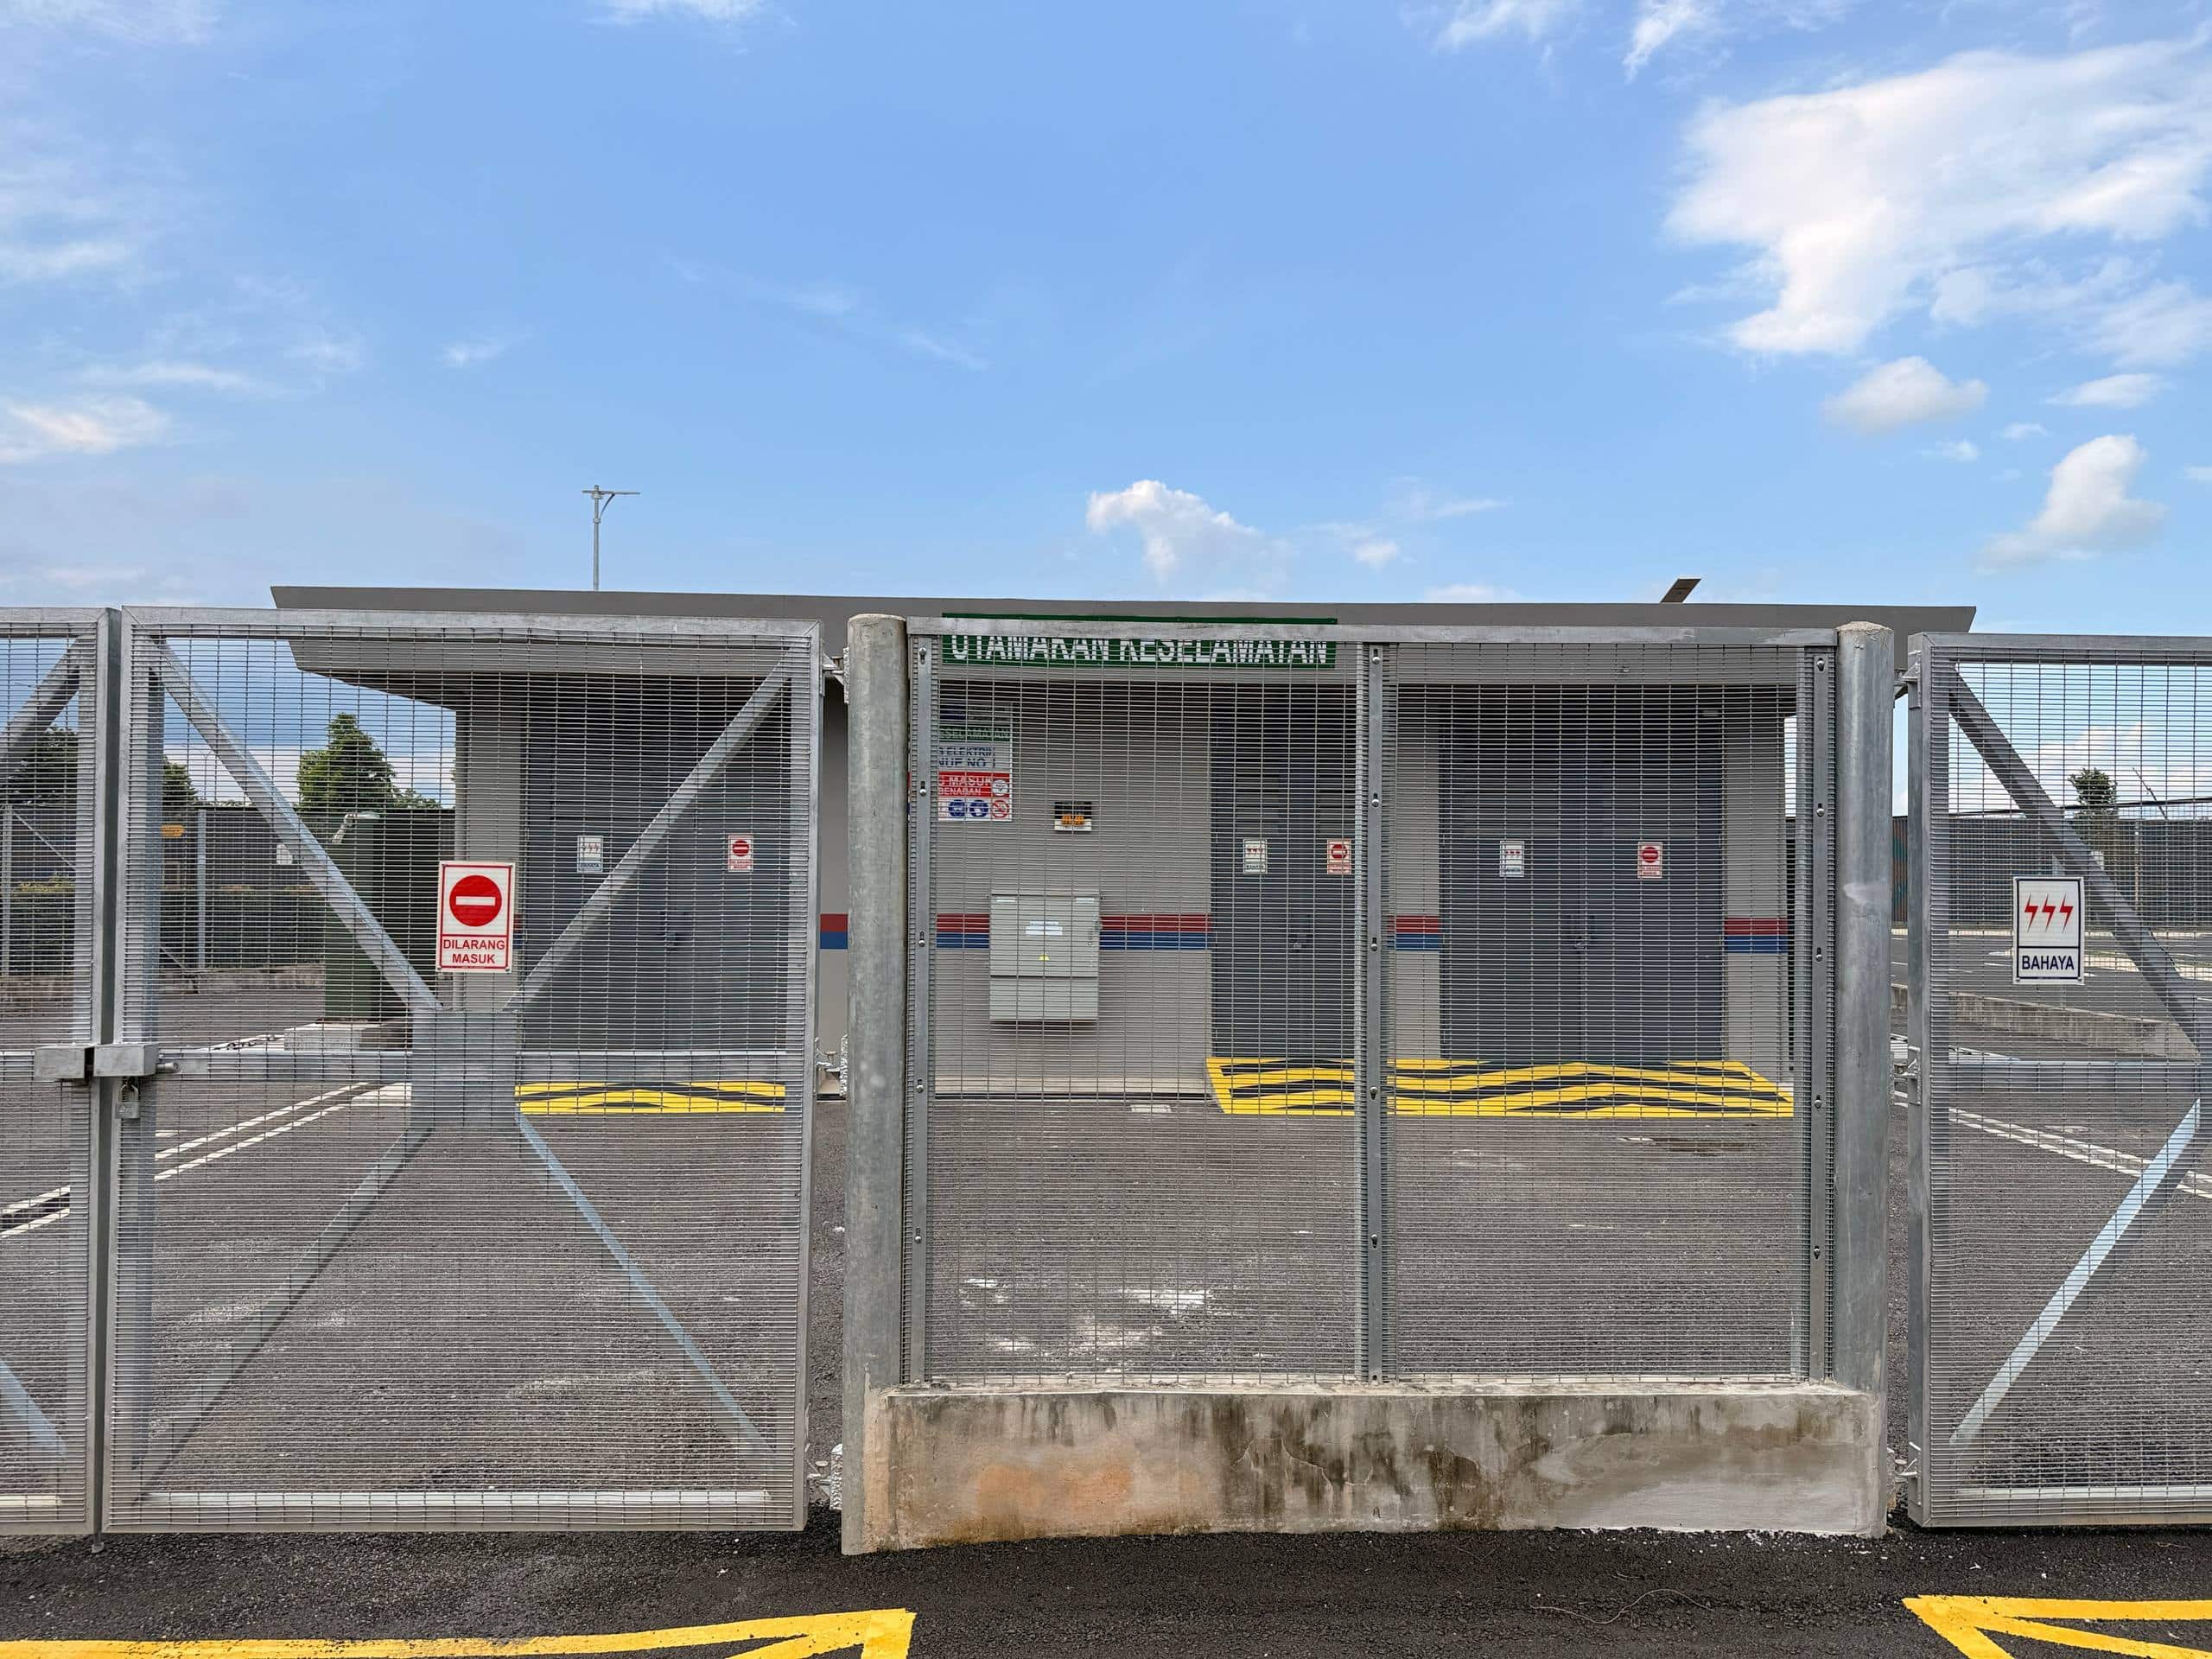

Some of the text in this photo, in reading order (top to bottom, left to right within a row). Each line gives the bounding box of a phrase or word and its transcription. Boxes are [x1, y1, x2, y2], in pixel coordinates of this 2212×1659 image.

[443, 939, 505, 950] DILARANG
[452, 953, 495, 963] MASUK
[2022, 956, 2074, 969] BAHAYA
